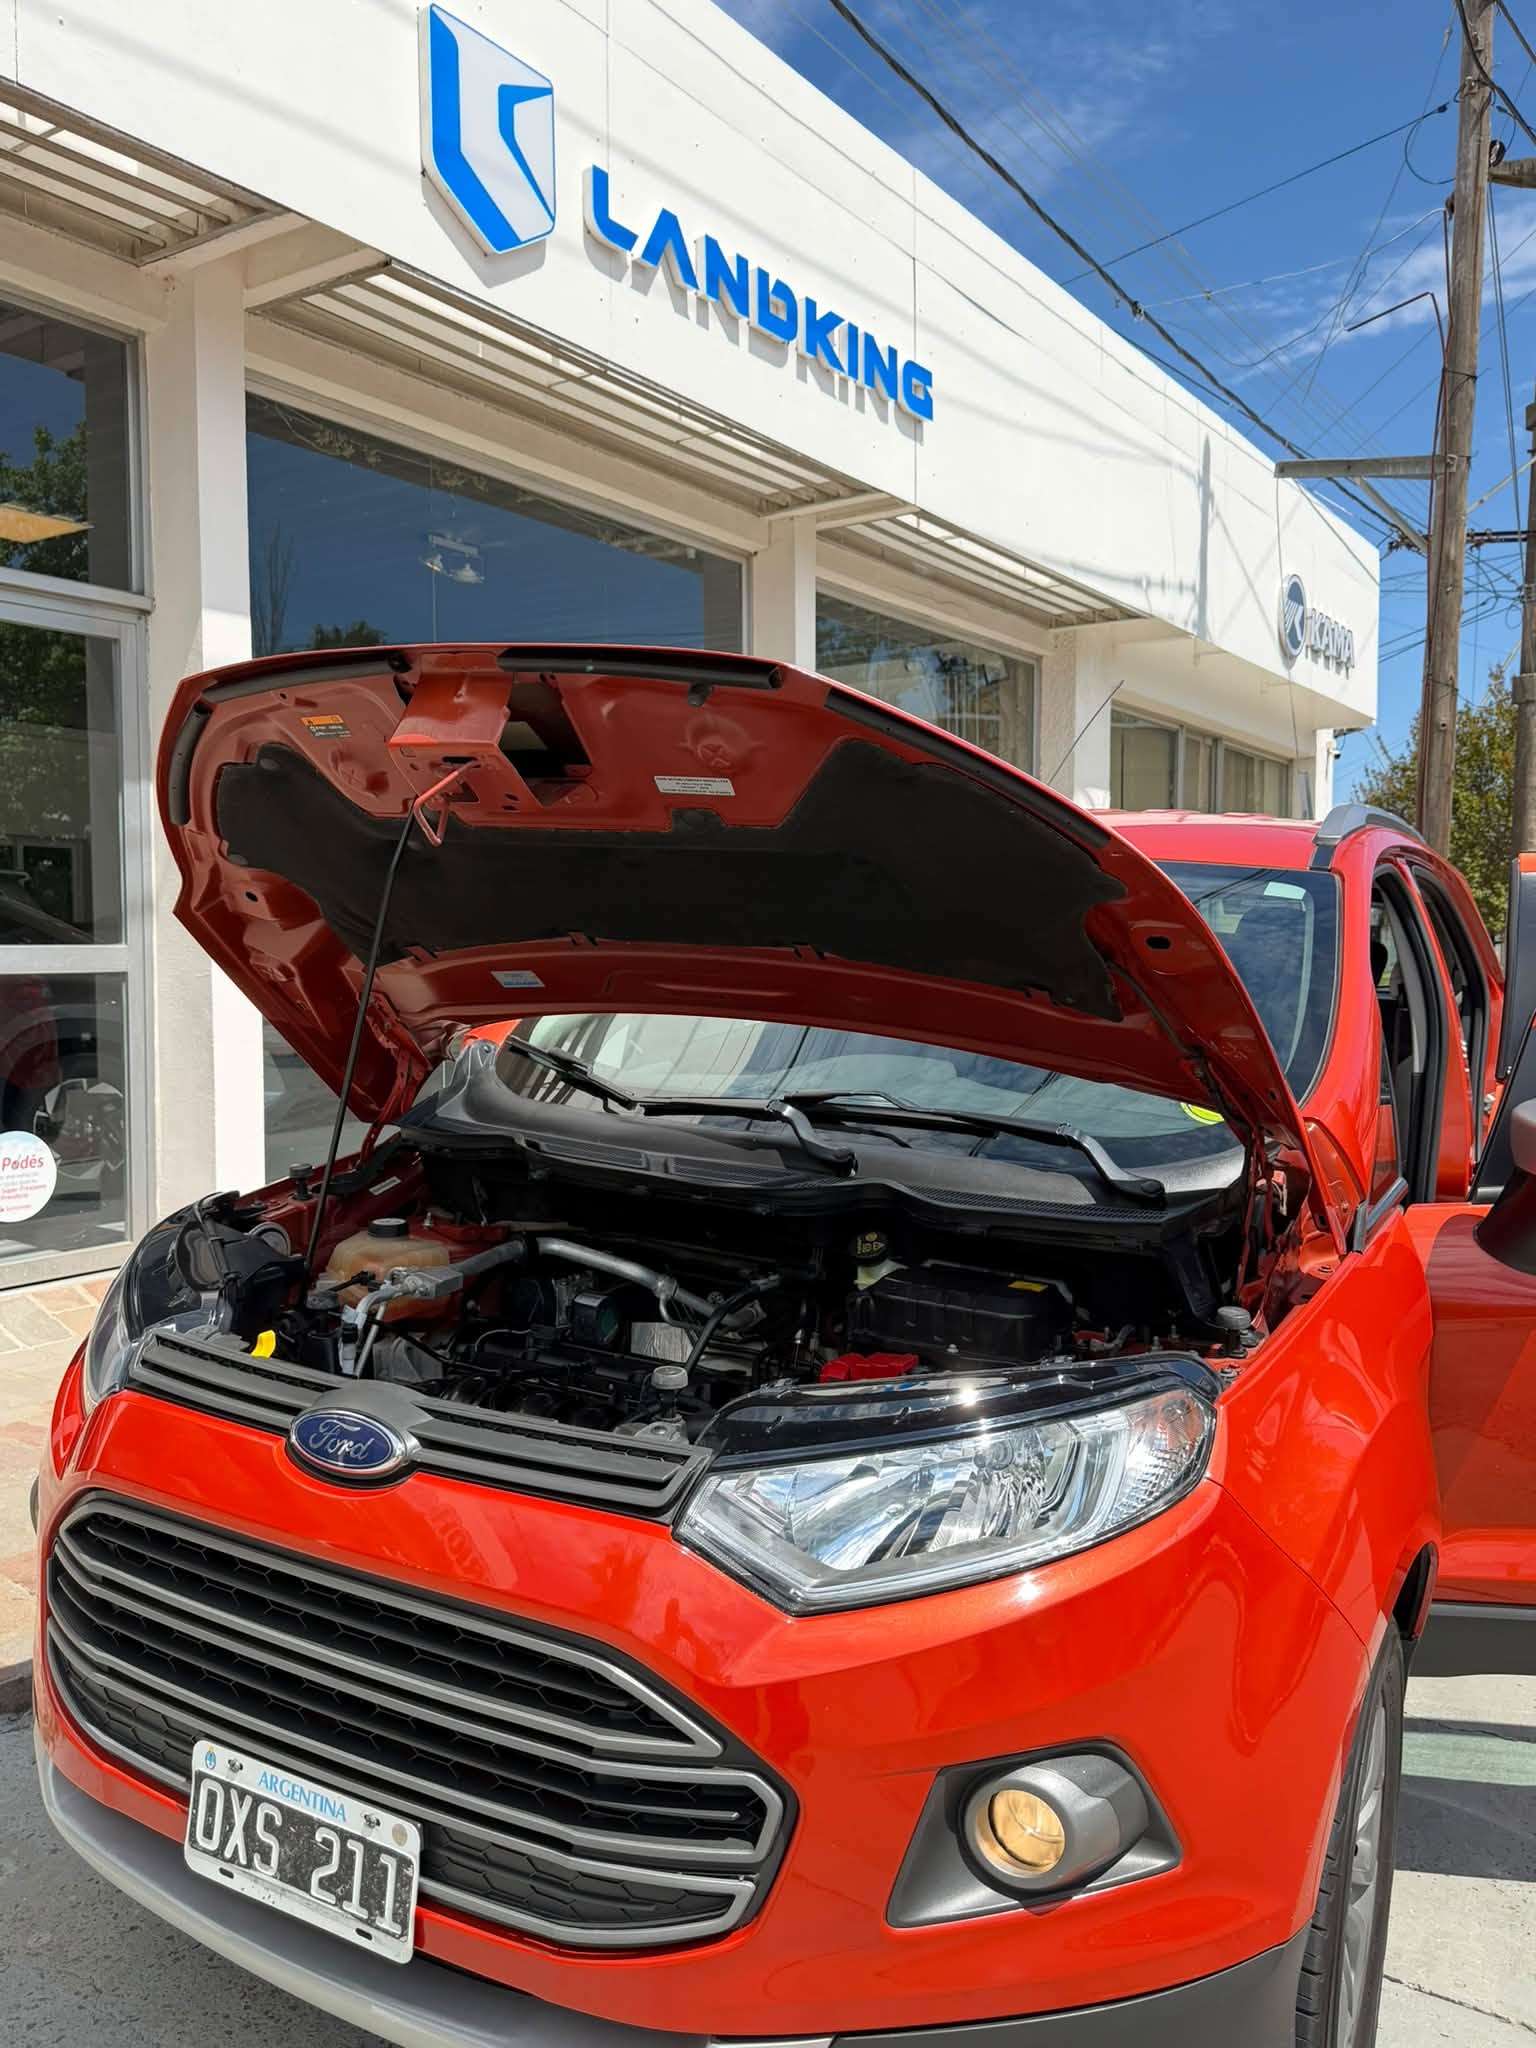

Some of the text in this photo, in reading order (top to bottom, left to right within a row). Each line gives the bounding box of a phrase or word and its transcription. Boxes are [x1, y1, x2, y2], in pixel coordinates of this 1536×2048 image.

[588, 164, 934, 422] LANDKING
[308, 1418, 376, 1460] Ford
[258, 1770, 347, 1822] ARGENTINA
[195, 1778, 402, 1935] OXS 211
